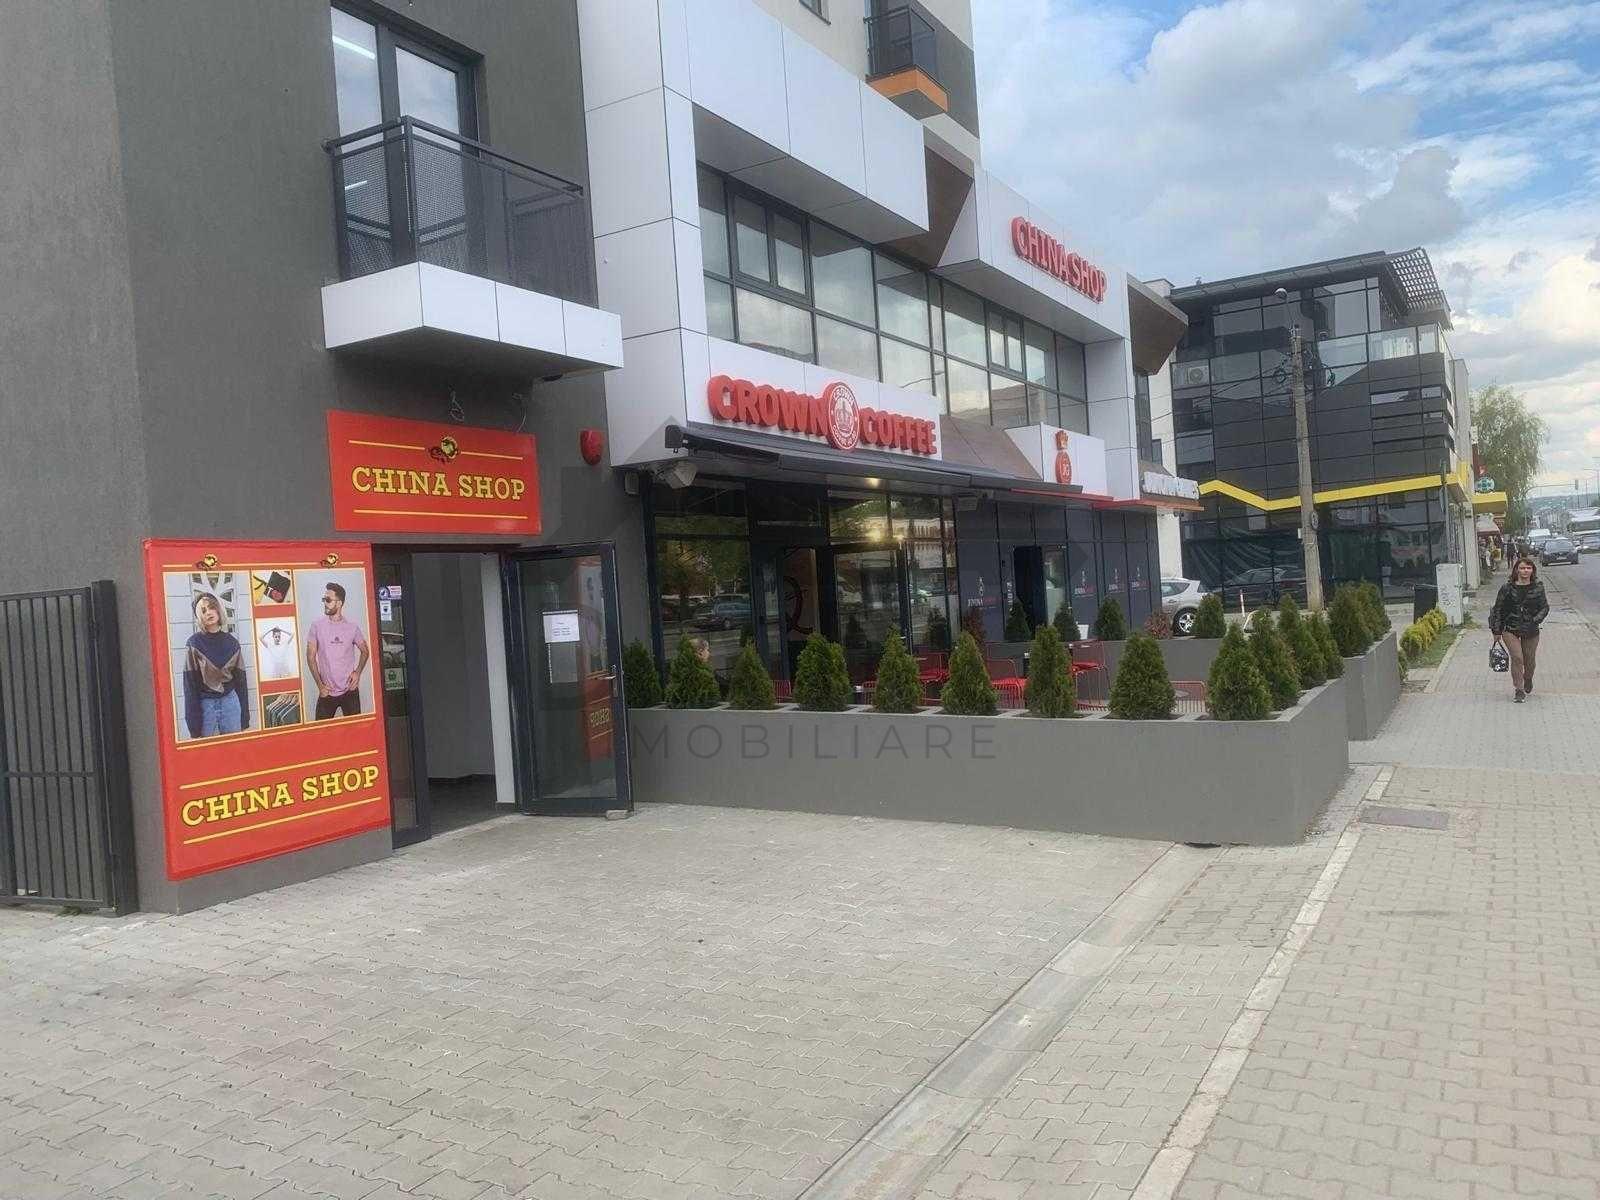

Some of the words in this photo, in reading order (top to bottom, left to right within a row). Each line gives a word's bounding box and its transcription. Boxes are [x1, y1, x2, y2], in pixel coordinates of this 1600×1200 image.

[1011, 216, 1069, 284] CHINA
[1067, 252, 1107, 304] SHOP
[708, 374, 829, 437] CROWN
[859, 406, 938, 455] COFFEE
[351, 466, 452, 497] CHINA
[457, 474, 526, 500] SHOP
[181, 782, 296, 827] CHINA
[301, 764, 380, 802] SHOP
